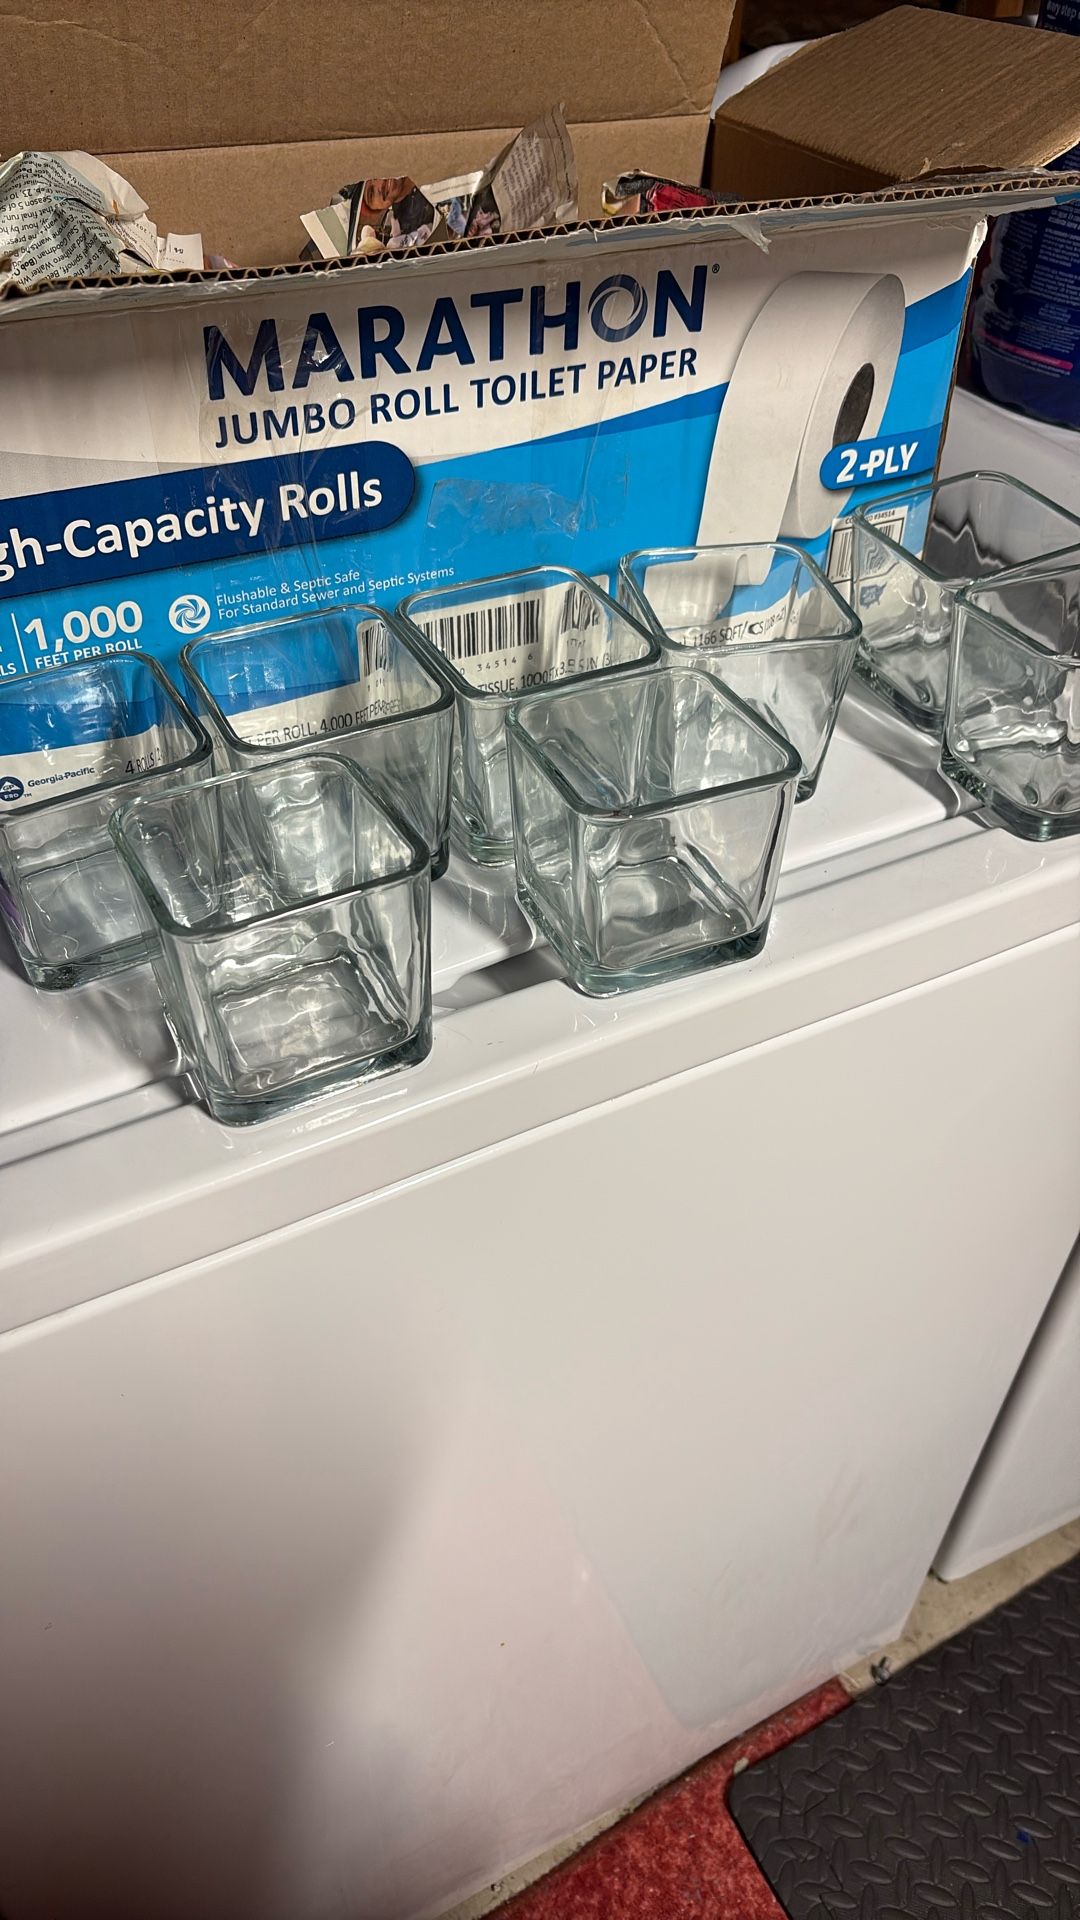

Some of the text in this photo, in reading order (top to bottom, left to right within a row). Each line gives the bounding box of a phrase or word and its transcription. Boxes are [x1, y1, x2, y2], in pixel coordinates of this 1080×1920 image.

[24, 195, 53, 207] Season
[30, 262, 54, 278] Walter
[203, 265, 709, 401] MARATHON
[215, 347, 698, 449] JUMBO ROLL TOILET PAPER
[836, 441, 919, 484] 2-PLY
[0, 471, 384, 583] gh-Capacity Rolls
[216, 569, 360, 606] Flushable & Septic Safe
[218, 567, 455, 621] For Standard Sewer and Septic Systems
[24, 600, 144, 653] 1,000
[35, 638, 143, 669] FEET PER ROLL
[27, 767, 96, 788] Georgia-Pacific
